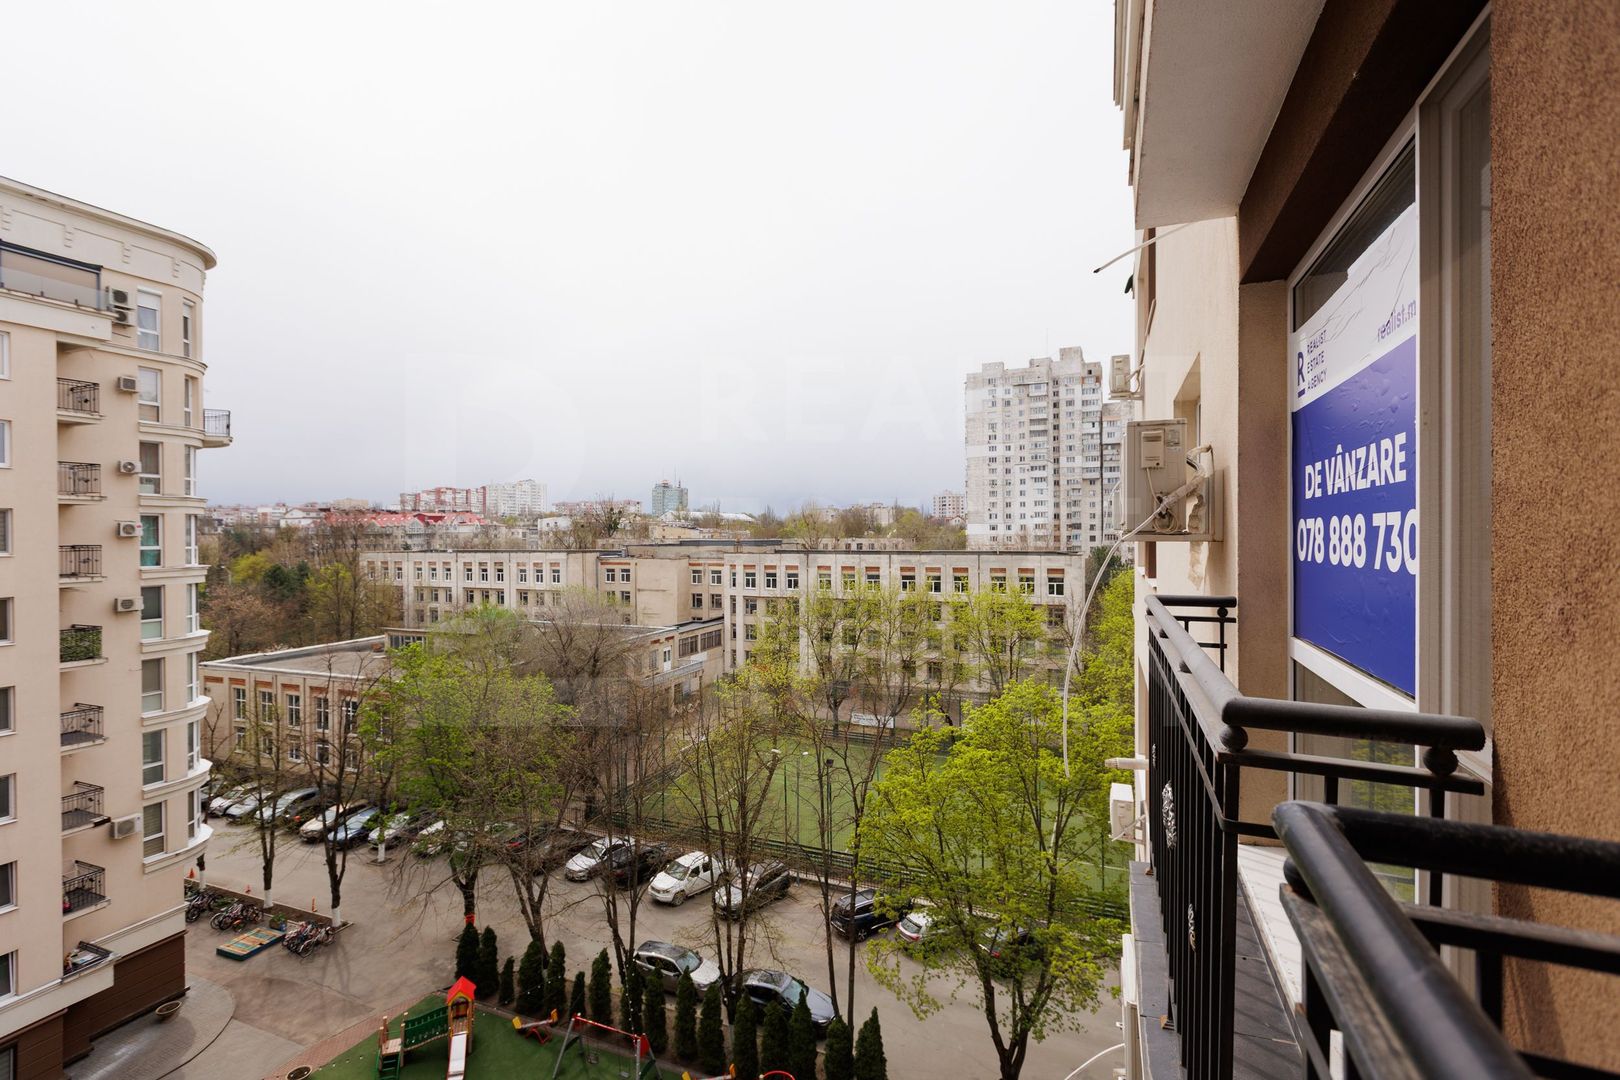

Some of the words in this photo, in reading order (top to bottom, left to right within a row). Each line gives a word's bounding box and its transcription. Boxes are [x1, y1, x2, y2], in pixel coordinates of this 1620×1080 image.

[1306, 329, 1327, 354] REALIST
[1297, 351, 1306, 387] R
[1306, 350, 1325, 374] ESTATE
[1306, 367, 1328, 390] AGENCY
[1305, 461, 1322, 499] DE
[1324, 432, 1407, 496] VÂNZARE
[1297, 517, 1325, 564] 078
[1329, 513, 1367, 569] 888
[1372, 508, 1417, 575] 730
